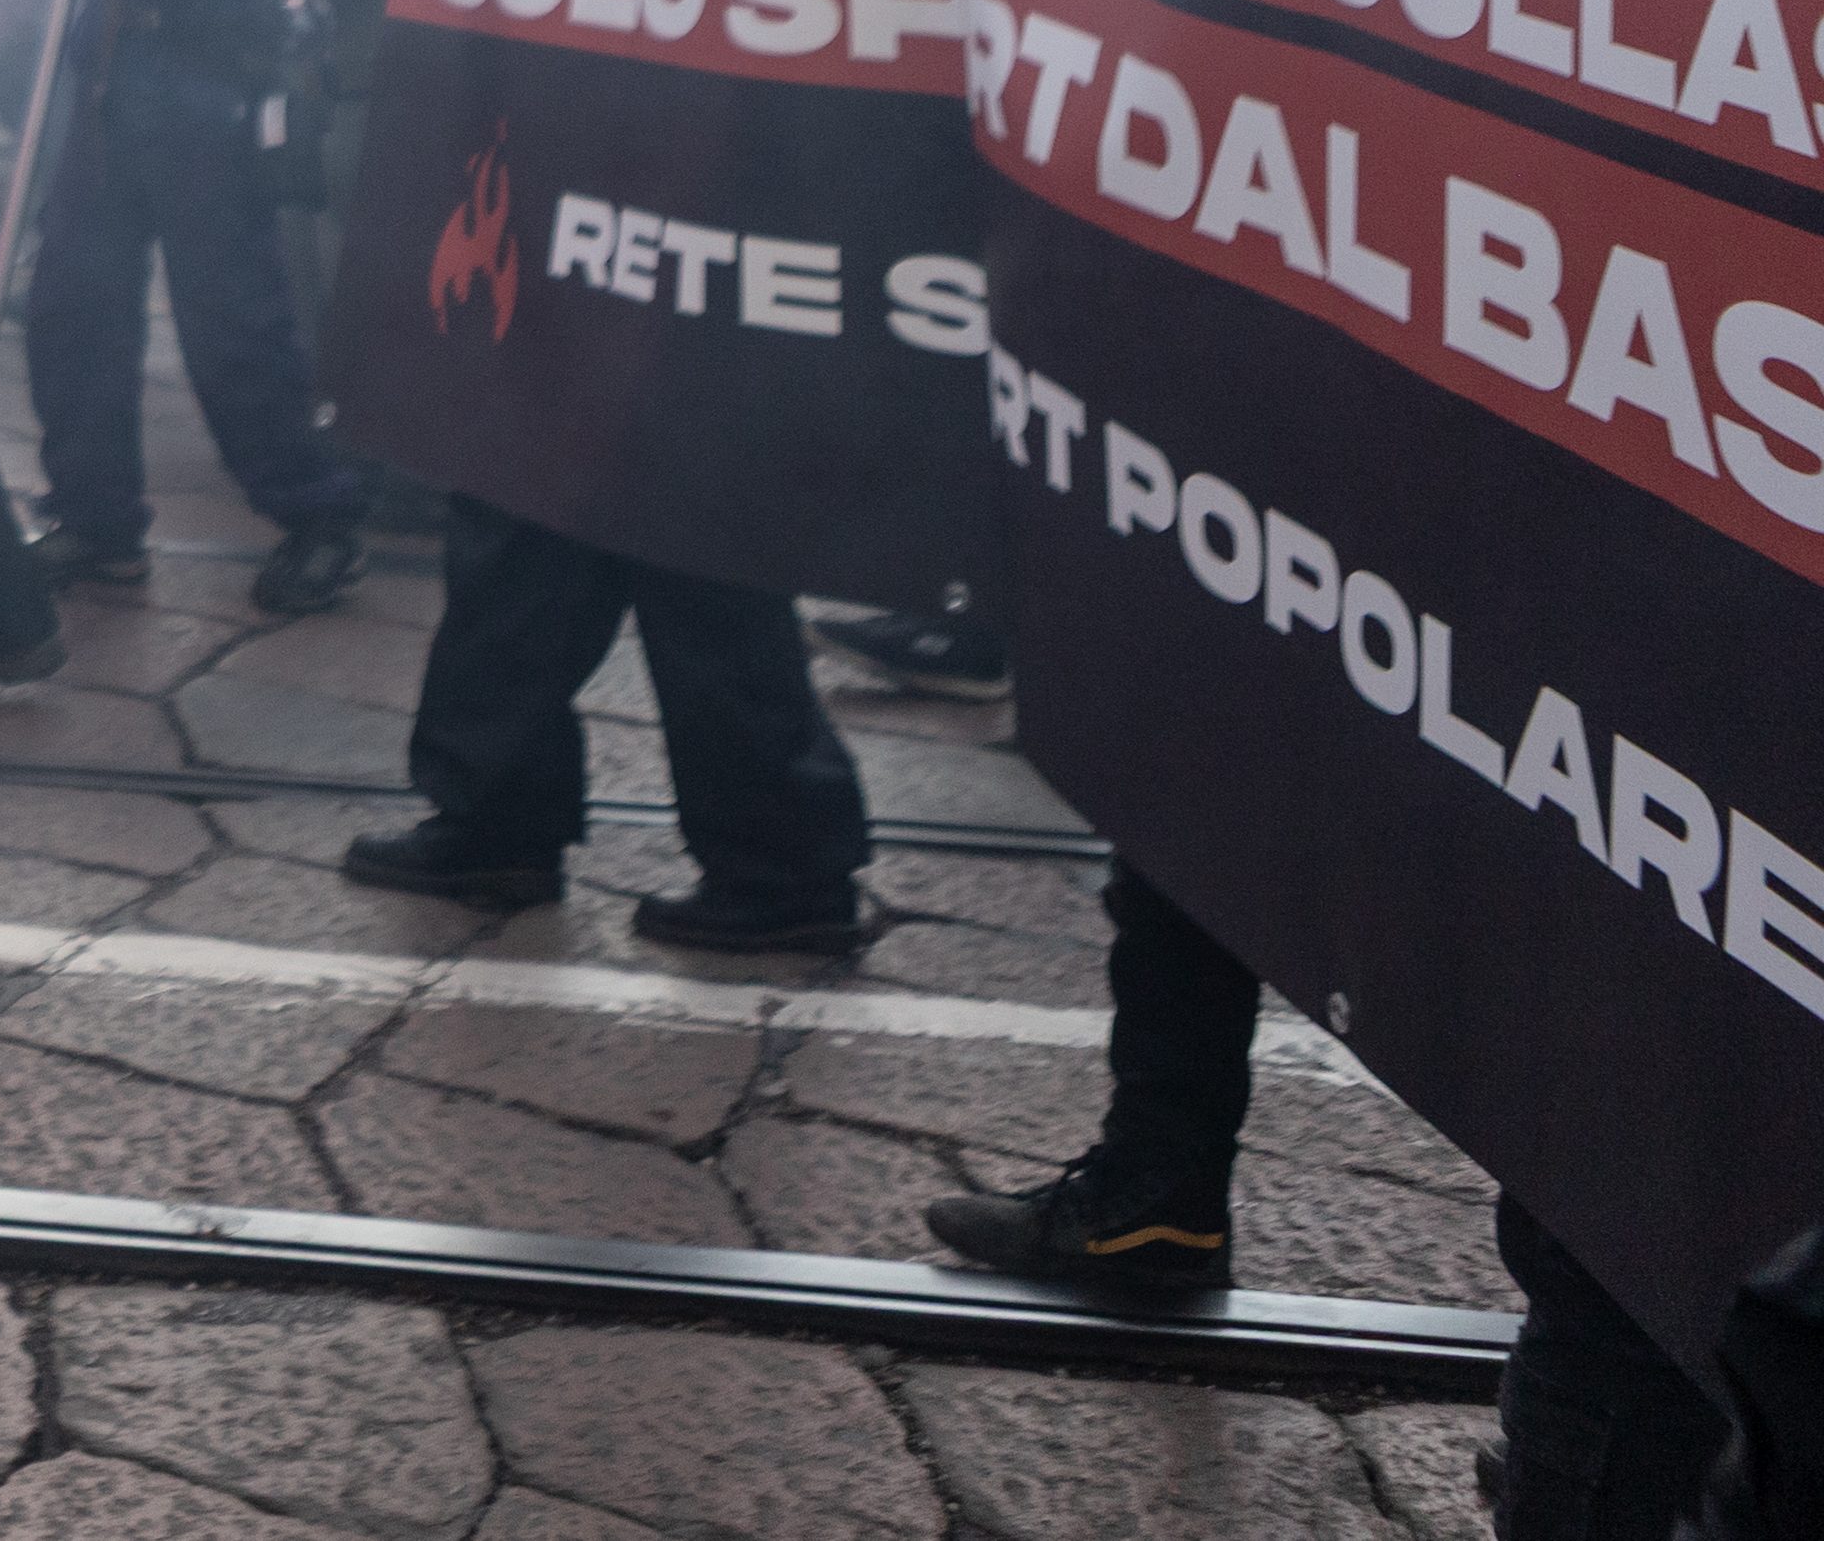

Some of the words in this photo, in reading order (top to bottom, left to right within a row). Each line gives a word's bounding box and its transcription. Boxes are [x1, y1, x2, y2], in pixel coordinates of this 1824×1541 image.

[1095, 52, 1412, 325] DAL
[546, 192, 844, 338] RETE
[1103, 419, 1824, 1023] POPOLARE
